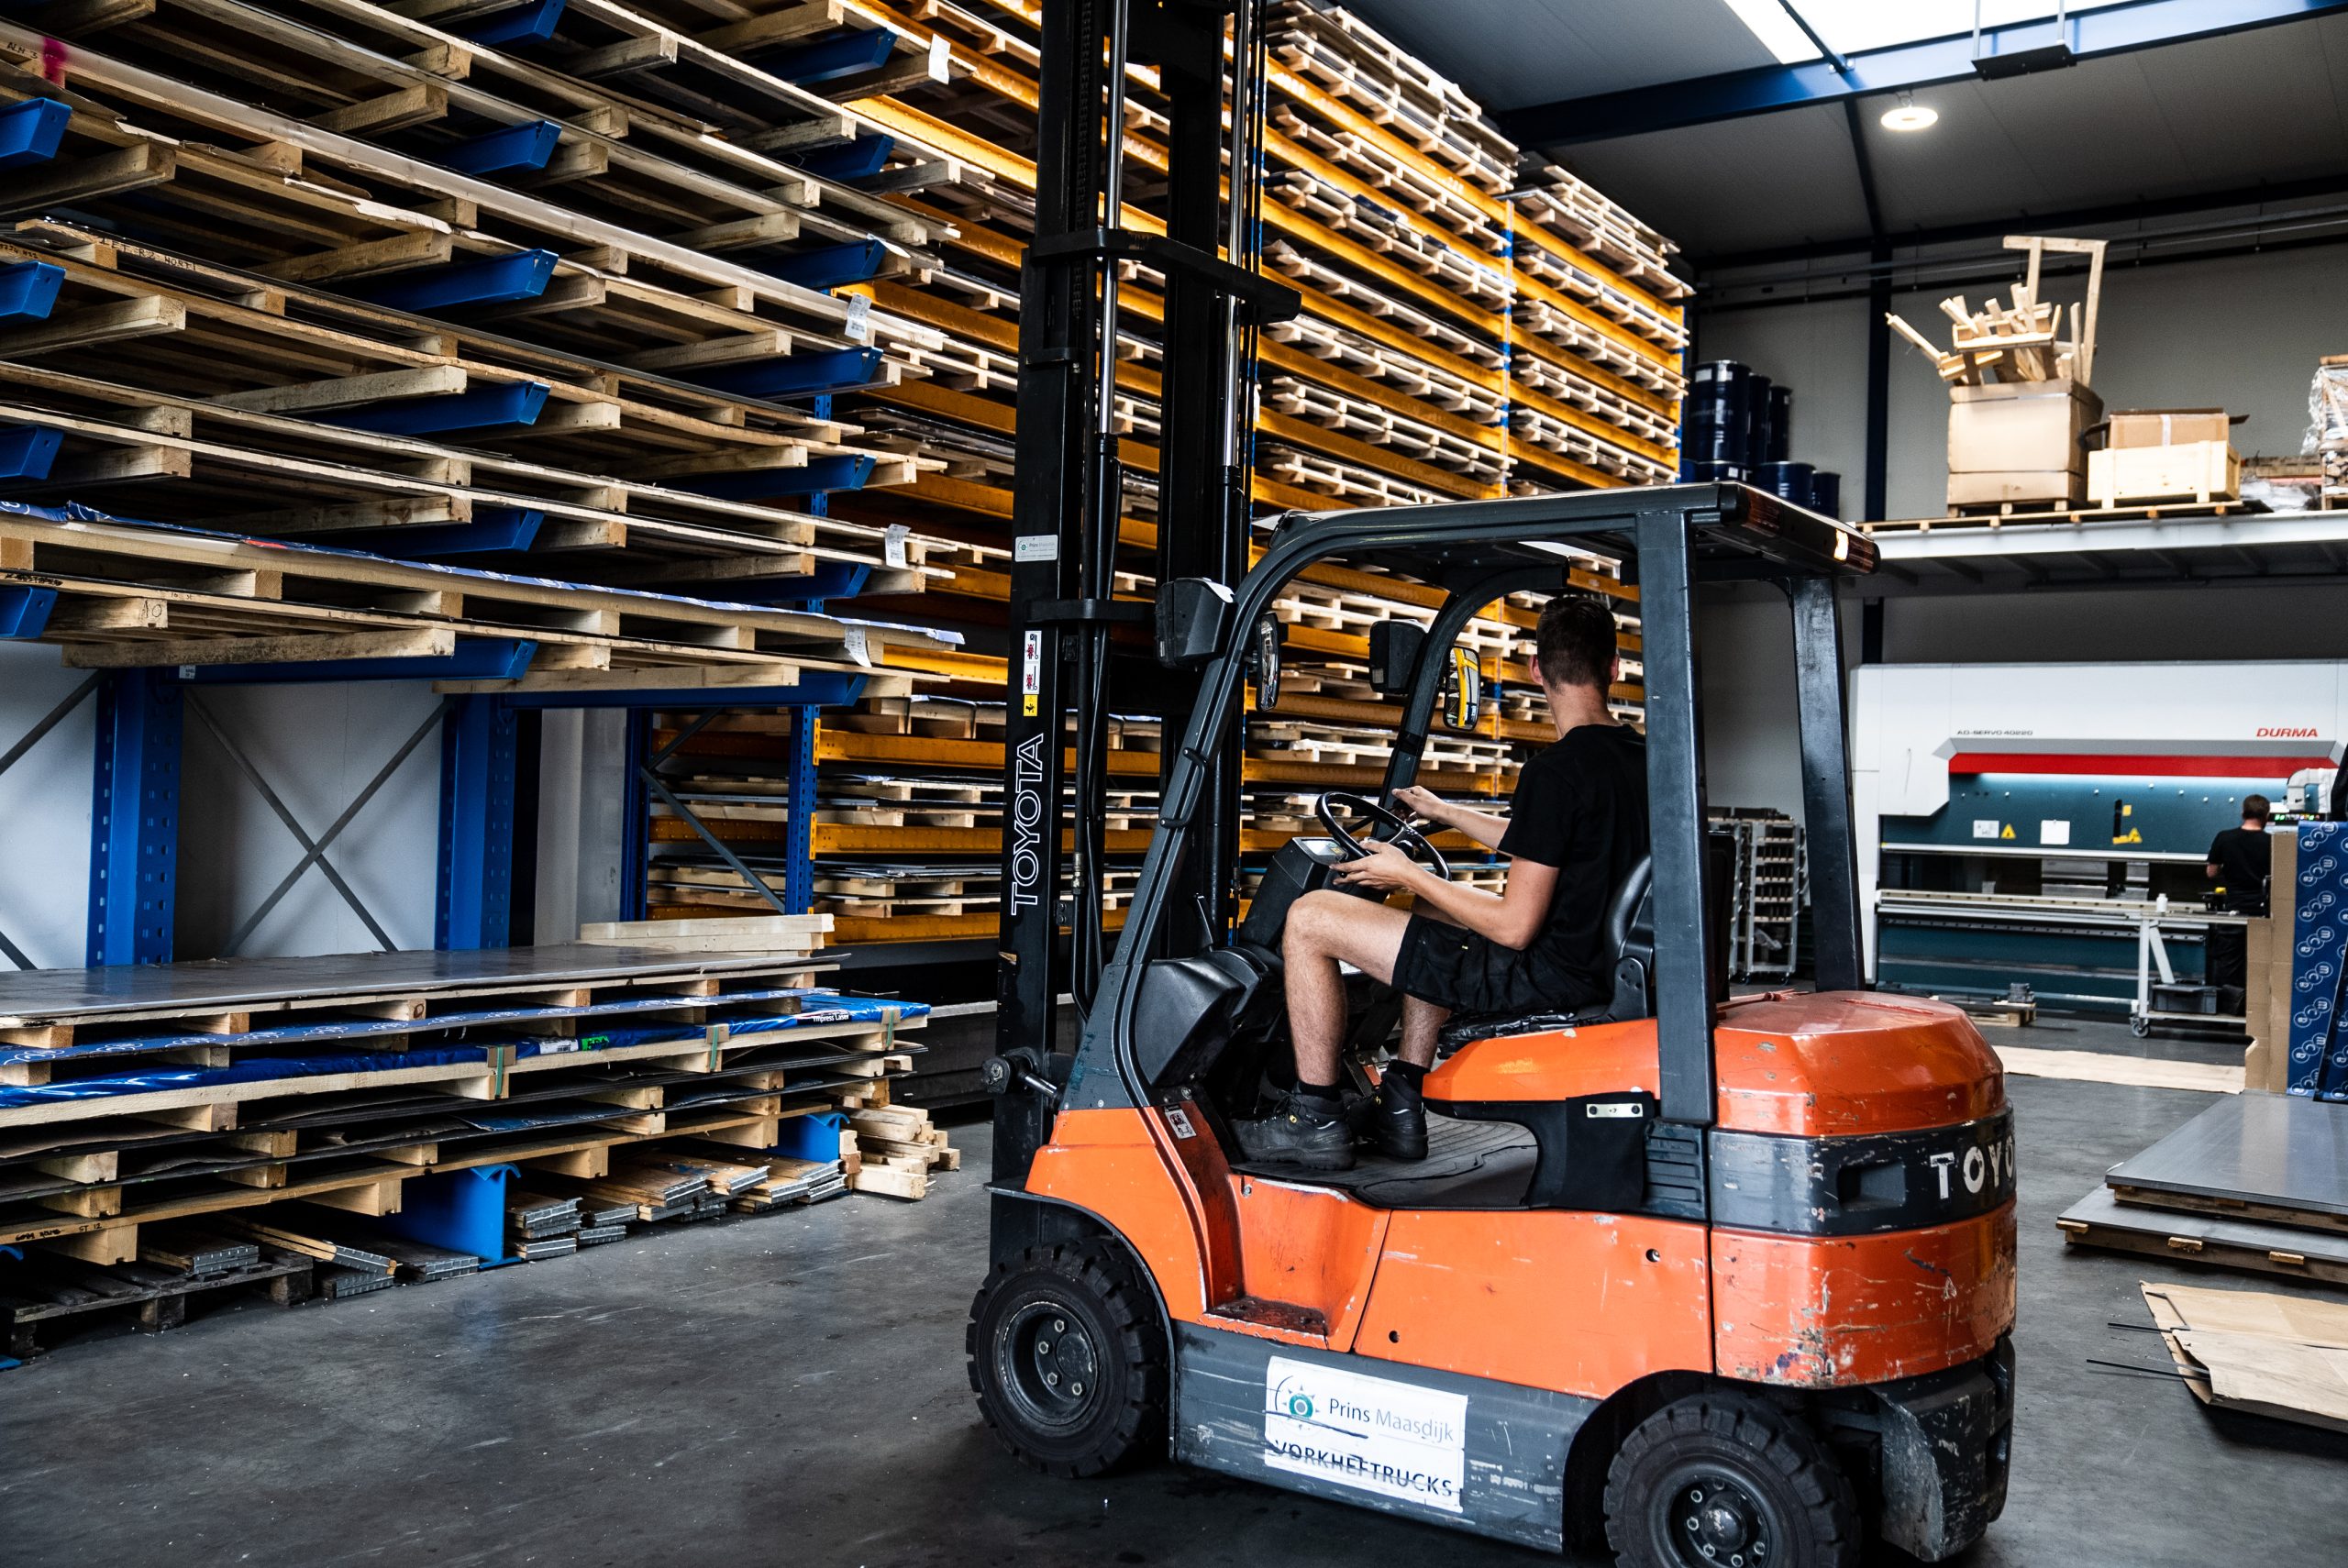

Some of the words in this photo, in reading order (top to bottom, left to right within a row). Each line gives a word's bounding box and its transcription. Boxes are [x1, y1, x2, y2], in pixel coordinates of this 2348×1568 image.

[2256, 727, 2319, 737] DURMA
[1011, 733, 1045, 916] TOYOTA
[1329, 1397, 1371, 1423] Prins
[1375, 1408, 1454, 1444] Maasdijk
[1275, 1439, 1453, 1498] VORKHEFTRUCKS
